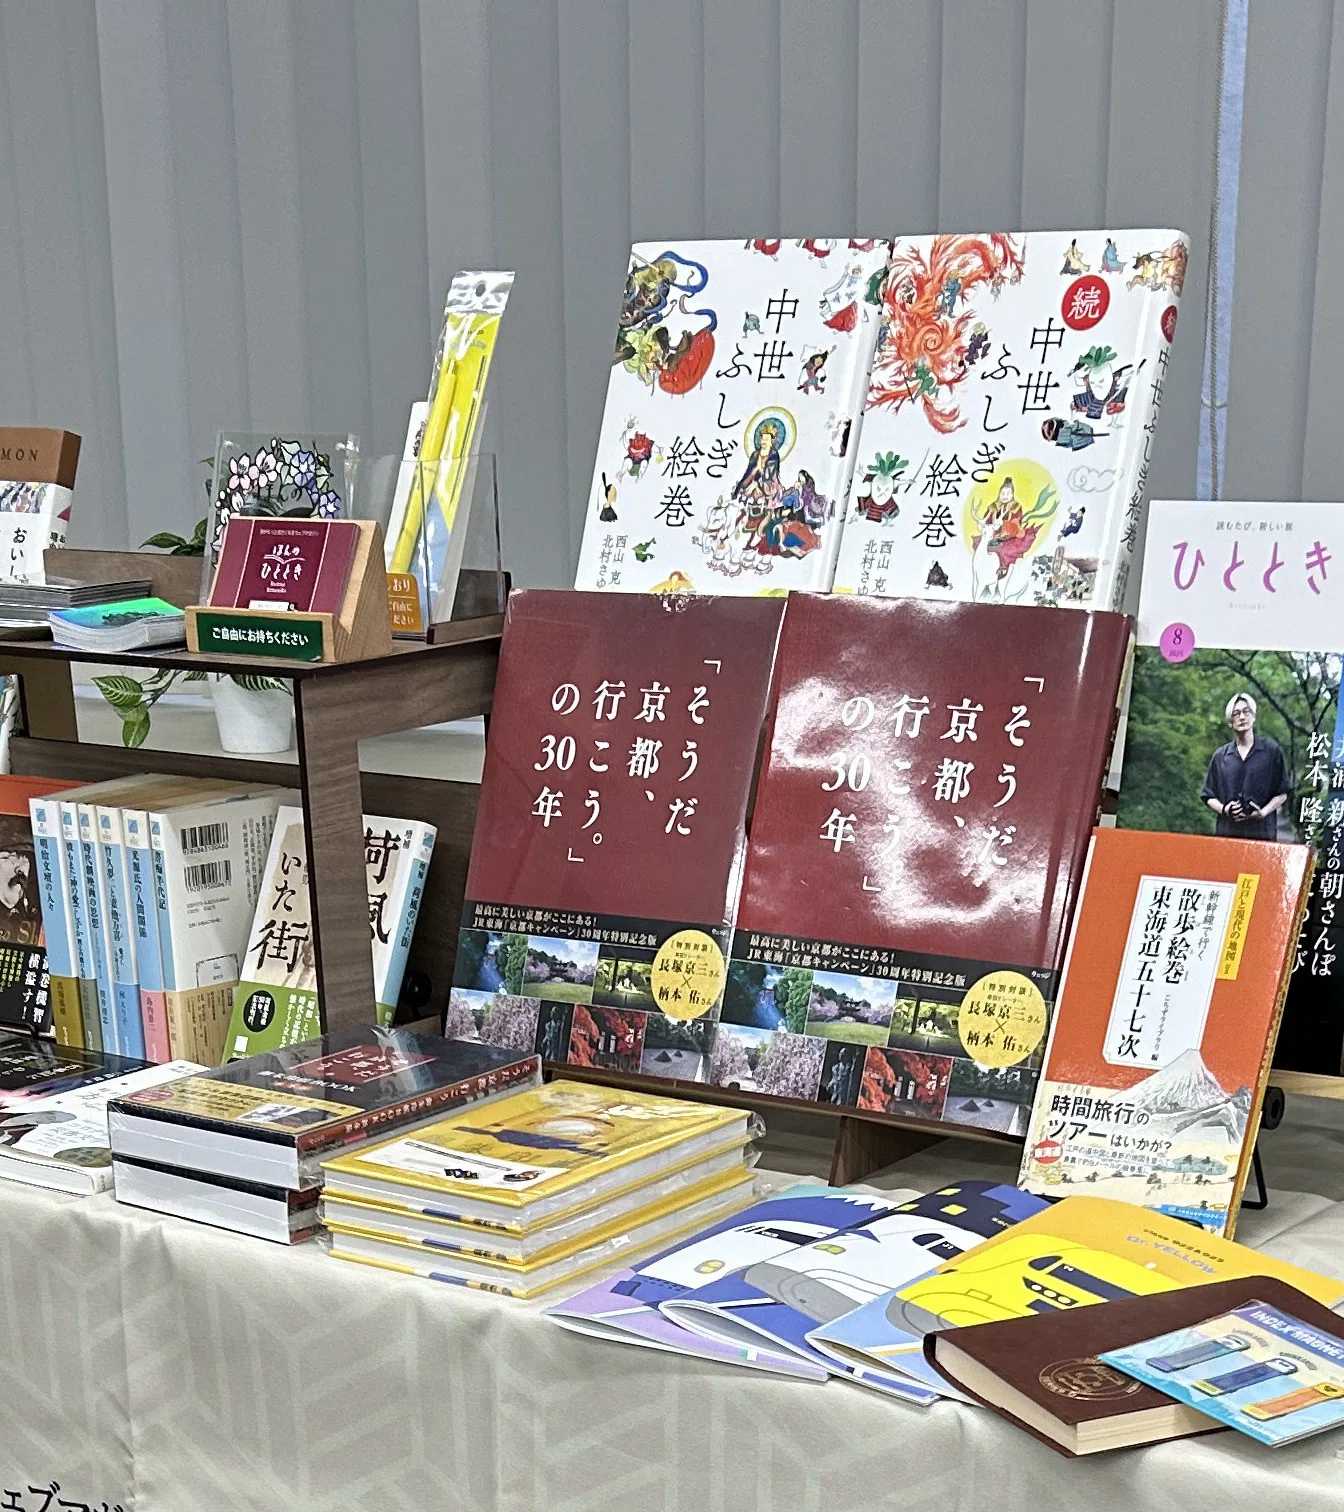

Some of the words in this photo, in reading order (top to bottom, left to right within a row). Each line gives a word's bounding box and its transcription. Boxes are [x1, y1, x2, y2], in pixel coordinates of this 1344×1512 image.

[755, 288, 800, 383] 中世
[1068, 286, 1102, 321] 続
[705, 346, 754, 478] ふしぎ
[1017, 316, 1067, 415] 中世
[970, 343, 1022, 483] ふしぎ
[653, 435, 706, 529] 絵巻
[913, 453, 965, 550] 絵巻
[261, 562, 303, 581] ひととき
[614, 535, 628, 563] 西山
[877, 540, 895, 564] 西山
[1173, 541, 1332, 595] ひととき
[212, 626, 309, 646] ご自由にお持ちください
[1172, 628, 1183, 646] 8
[531, 681, 581, 829] の30年
[625, 682, 672, 804] 京都、
[664, 659, 724, 837] 「そうだ
[819, 694, 875, 853] の30年
[931, 697, 985, 828] 京都、
[976, 676, 1045, 867] 「そうだ
[1304, 731, 1332, 789] 松本
[249, 851, 309, 973] いた街
[1162, 887, 1202, 985] 散歩絵巻
[1197, 889, 1221, 961] 新幹線で行く
[967, 1000, 1042, 1026] 長塚京三さん
[1117, 885, 1174, 1059] 東海道五十七次
[1048, 1119, 1173, 1153] ツアーはいかが？
[1049, 1094, 1150, 1126] 時間旅行の
[1249, 1310, 1295, 1338] INDEX
